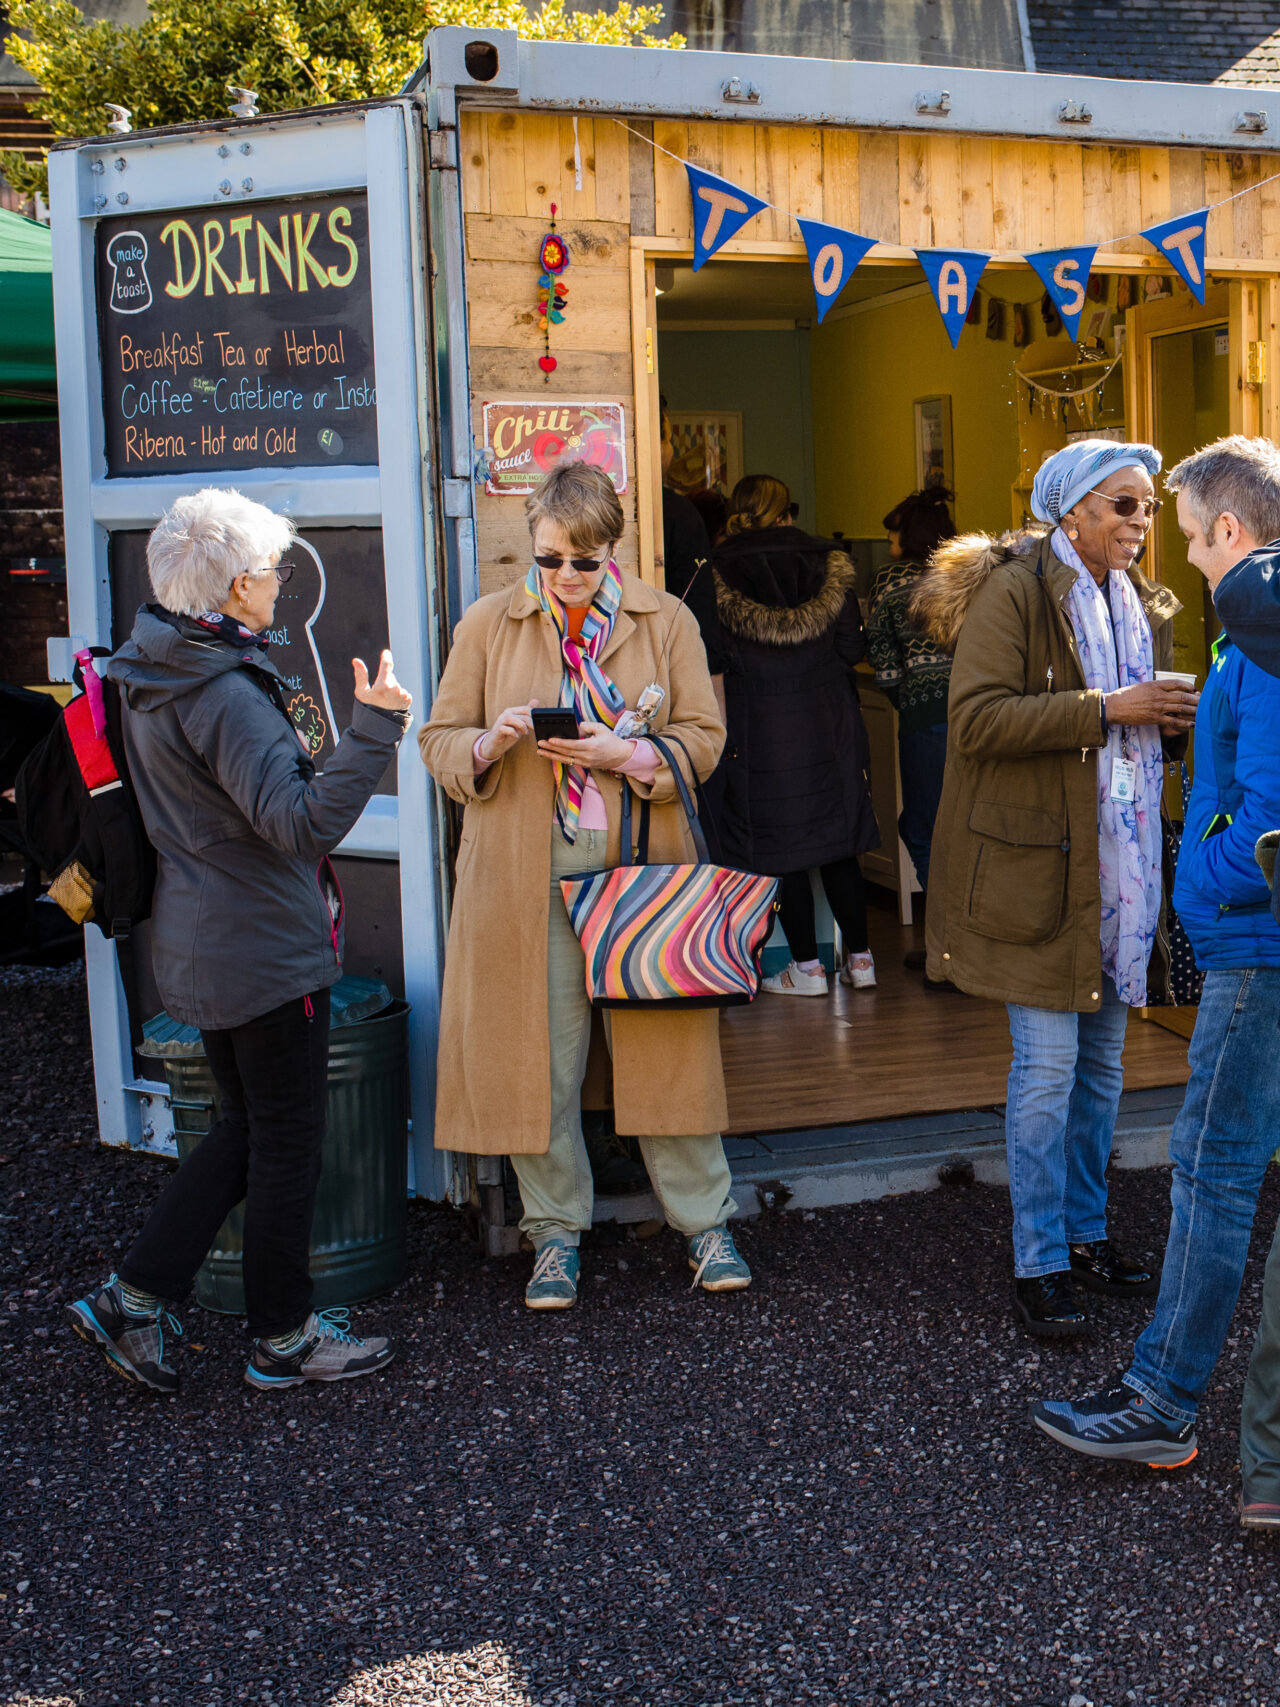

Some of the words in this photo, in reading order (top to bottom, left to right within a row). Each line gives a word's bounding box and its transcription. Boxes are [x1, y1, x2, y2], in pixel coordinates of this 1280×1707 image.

[116, 245, 144, 263] make
[126, 266, 136, 278] a
[160, 206, 359, 299] DRINKS
[117, 280, 146, 299] toast
[120, 331, 205, 375] Breakfast
[213, 331, 246, 367] Tea
[255, 347, 272, 366] or
[284, 329, 345, 366] Herbal
[121, 379, 193, 419] Coffee
[214, 376, 303, 413] Cafetiere
[313, 392, 328, 409] or
[125, 425, 187, 463] Ribena
[201, 424, 228, 456] Hot
[232, 426, 258, 452] and
[264, 426, 297, 456] Cold
[493, 409, 574, 458] Chili
[493, 449, 532, 472] sauce
